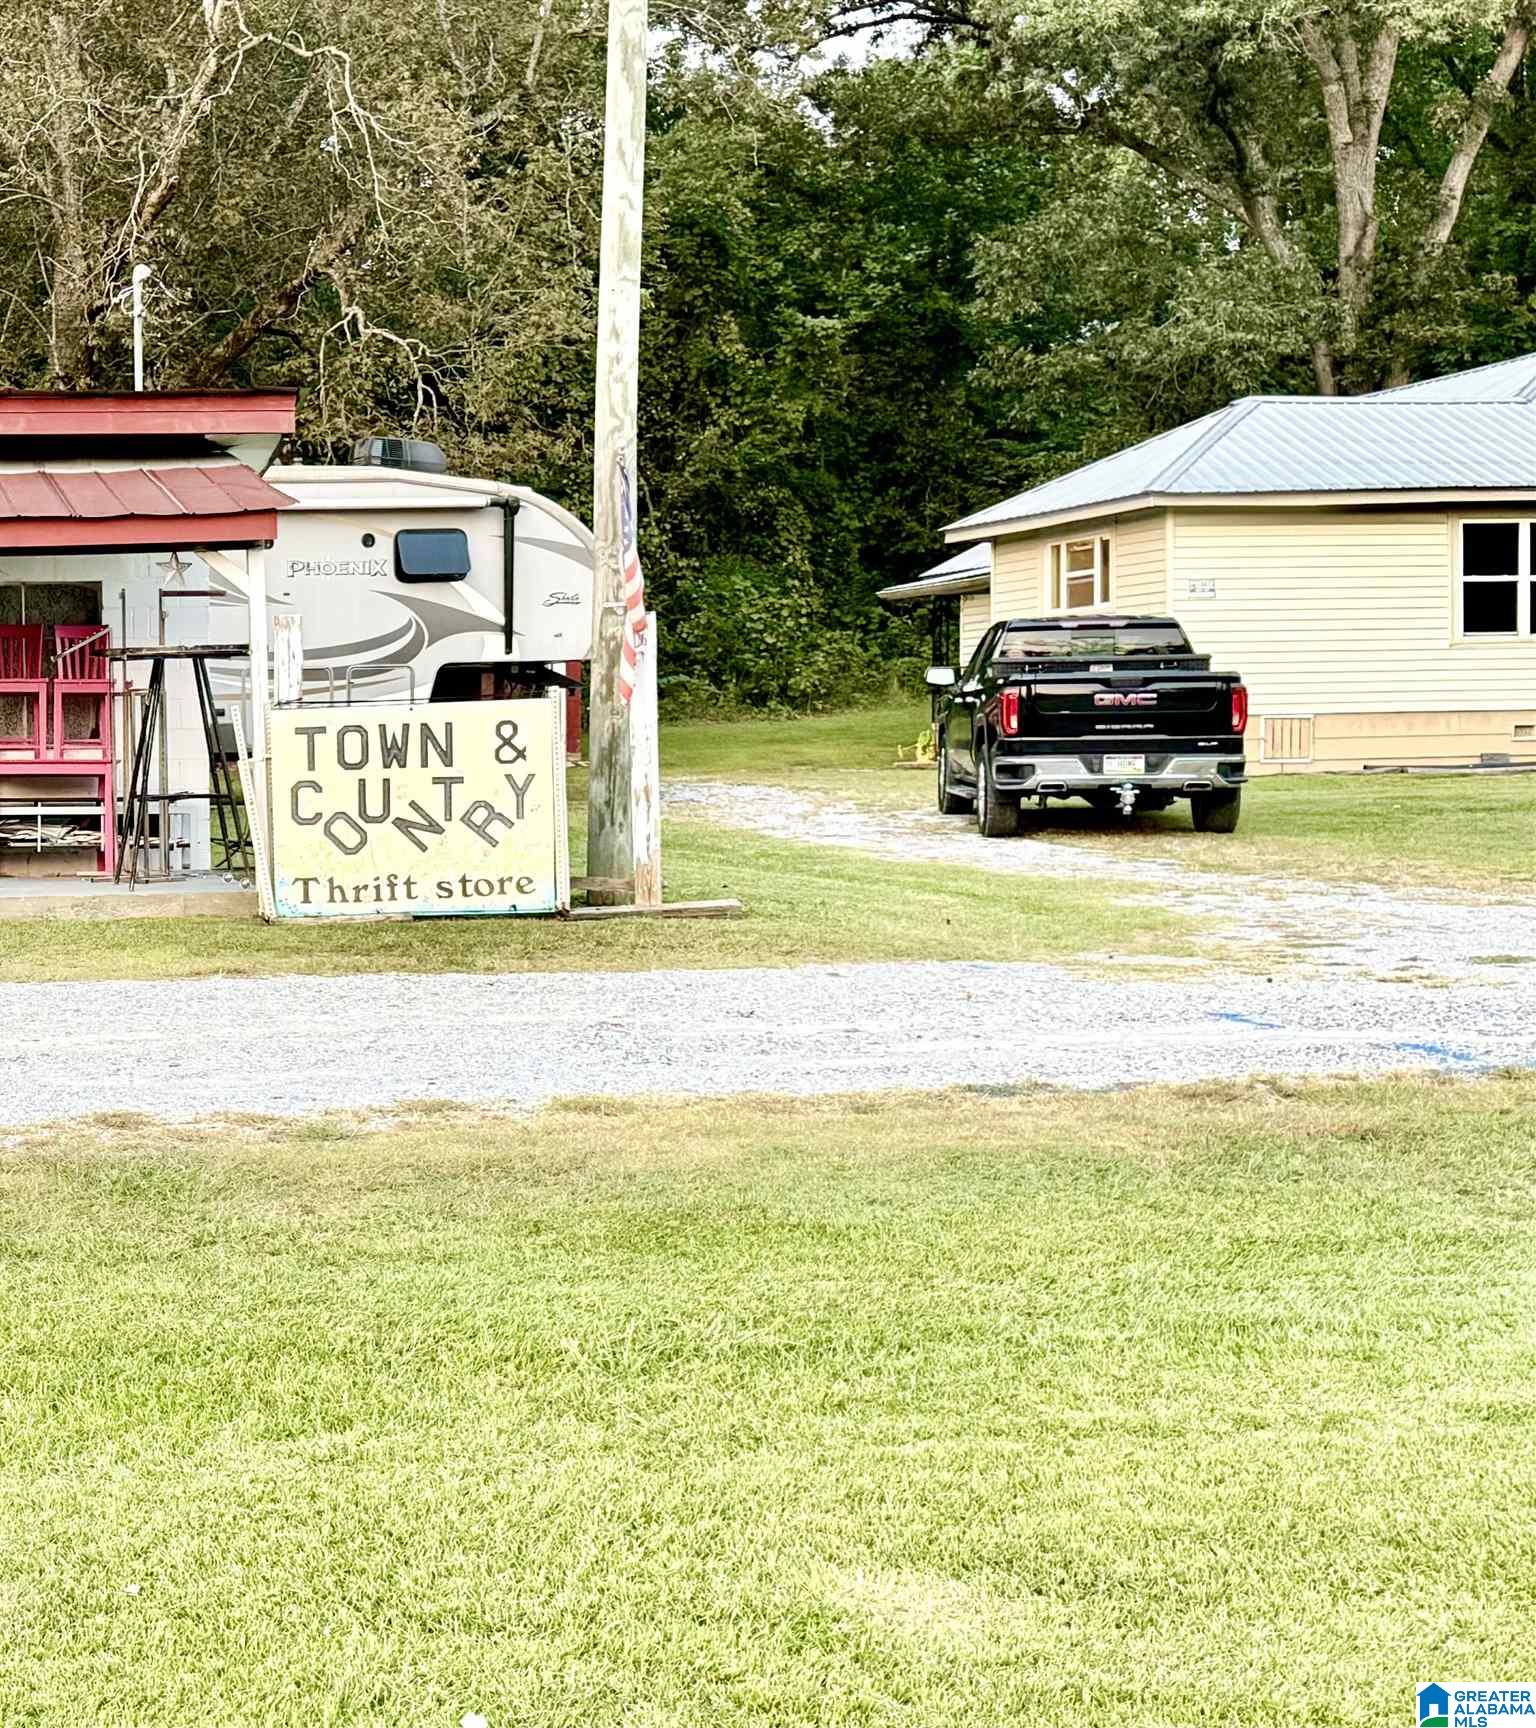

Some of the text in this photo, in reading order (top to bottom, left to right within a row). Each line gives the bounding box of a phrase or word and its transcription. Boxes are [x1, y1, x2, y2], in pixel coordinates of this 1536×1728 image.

[287, 559, 388, 578] PHOENIX
[1094, 693, 1158, 706] GMC
[294, 720, 527, 771] TOWN &
[290, 773, 536, 855] COUNTRY
[292, 873, 537, 904] Thrift store
